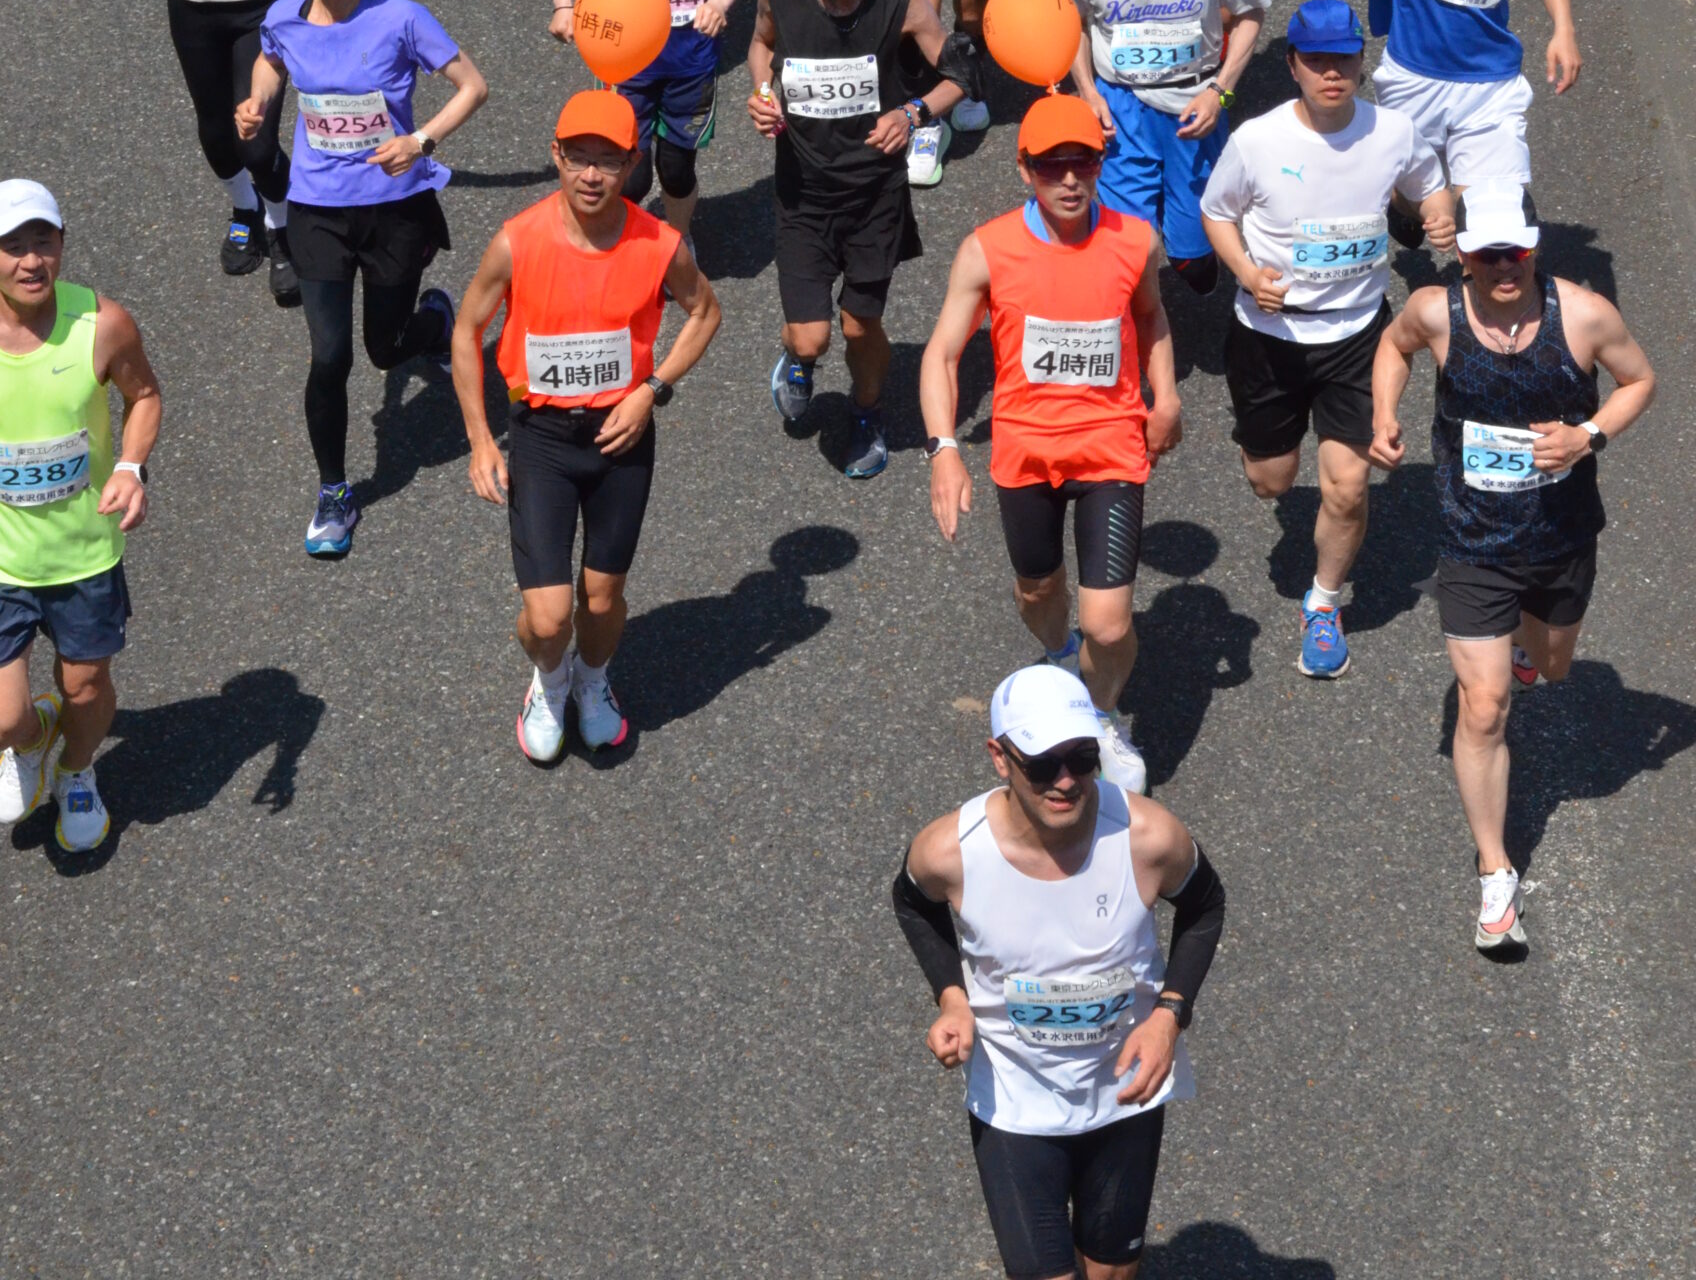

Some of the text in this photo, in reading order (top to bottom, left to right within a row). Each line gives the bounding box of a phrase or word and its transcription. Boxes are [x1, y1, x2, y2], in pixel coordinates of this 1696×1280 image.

[1114, 44, 1197, 67] C3211
[790, 62, 812, 74] TEL
[786, 79, 875, 101] C1305
[306, 112, 388, 135] D4254
[1301, 223, 1325, 237] TEL
[1296, 238, 1378, 264] C 342
[1038, 336, 1114, 350] ペースランナー
[540, 348, 618, 362] ペースランナー
[1032, 350, 1115, 378] 4時間
[539, 359, 621, 389] 4時間
[1472, 427, 1498, 443] TEL
[15, 483, 76, 503] 水沢信用金庫
[1012, 978, 1046, 995] TEL
[1011, 992, 1131, 1025] C2522
